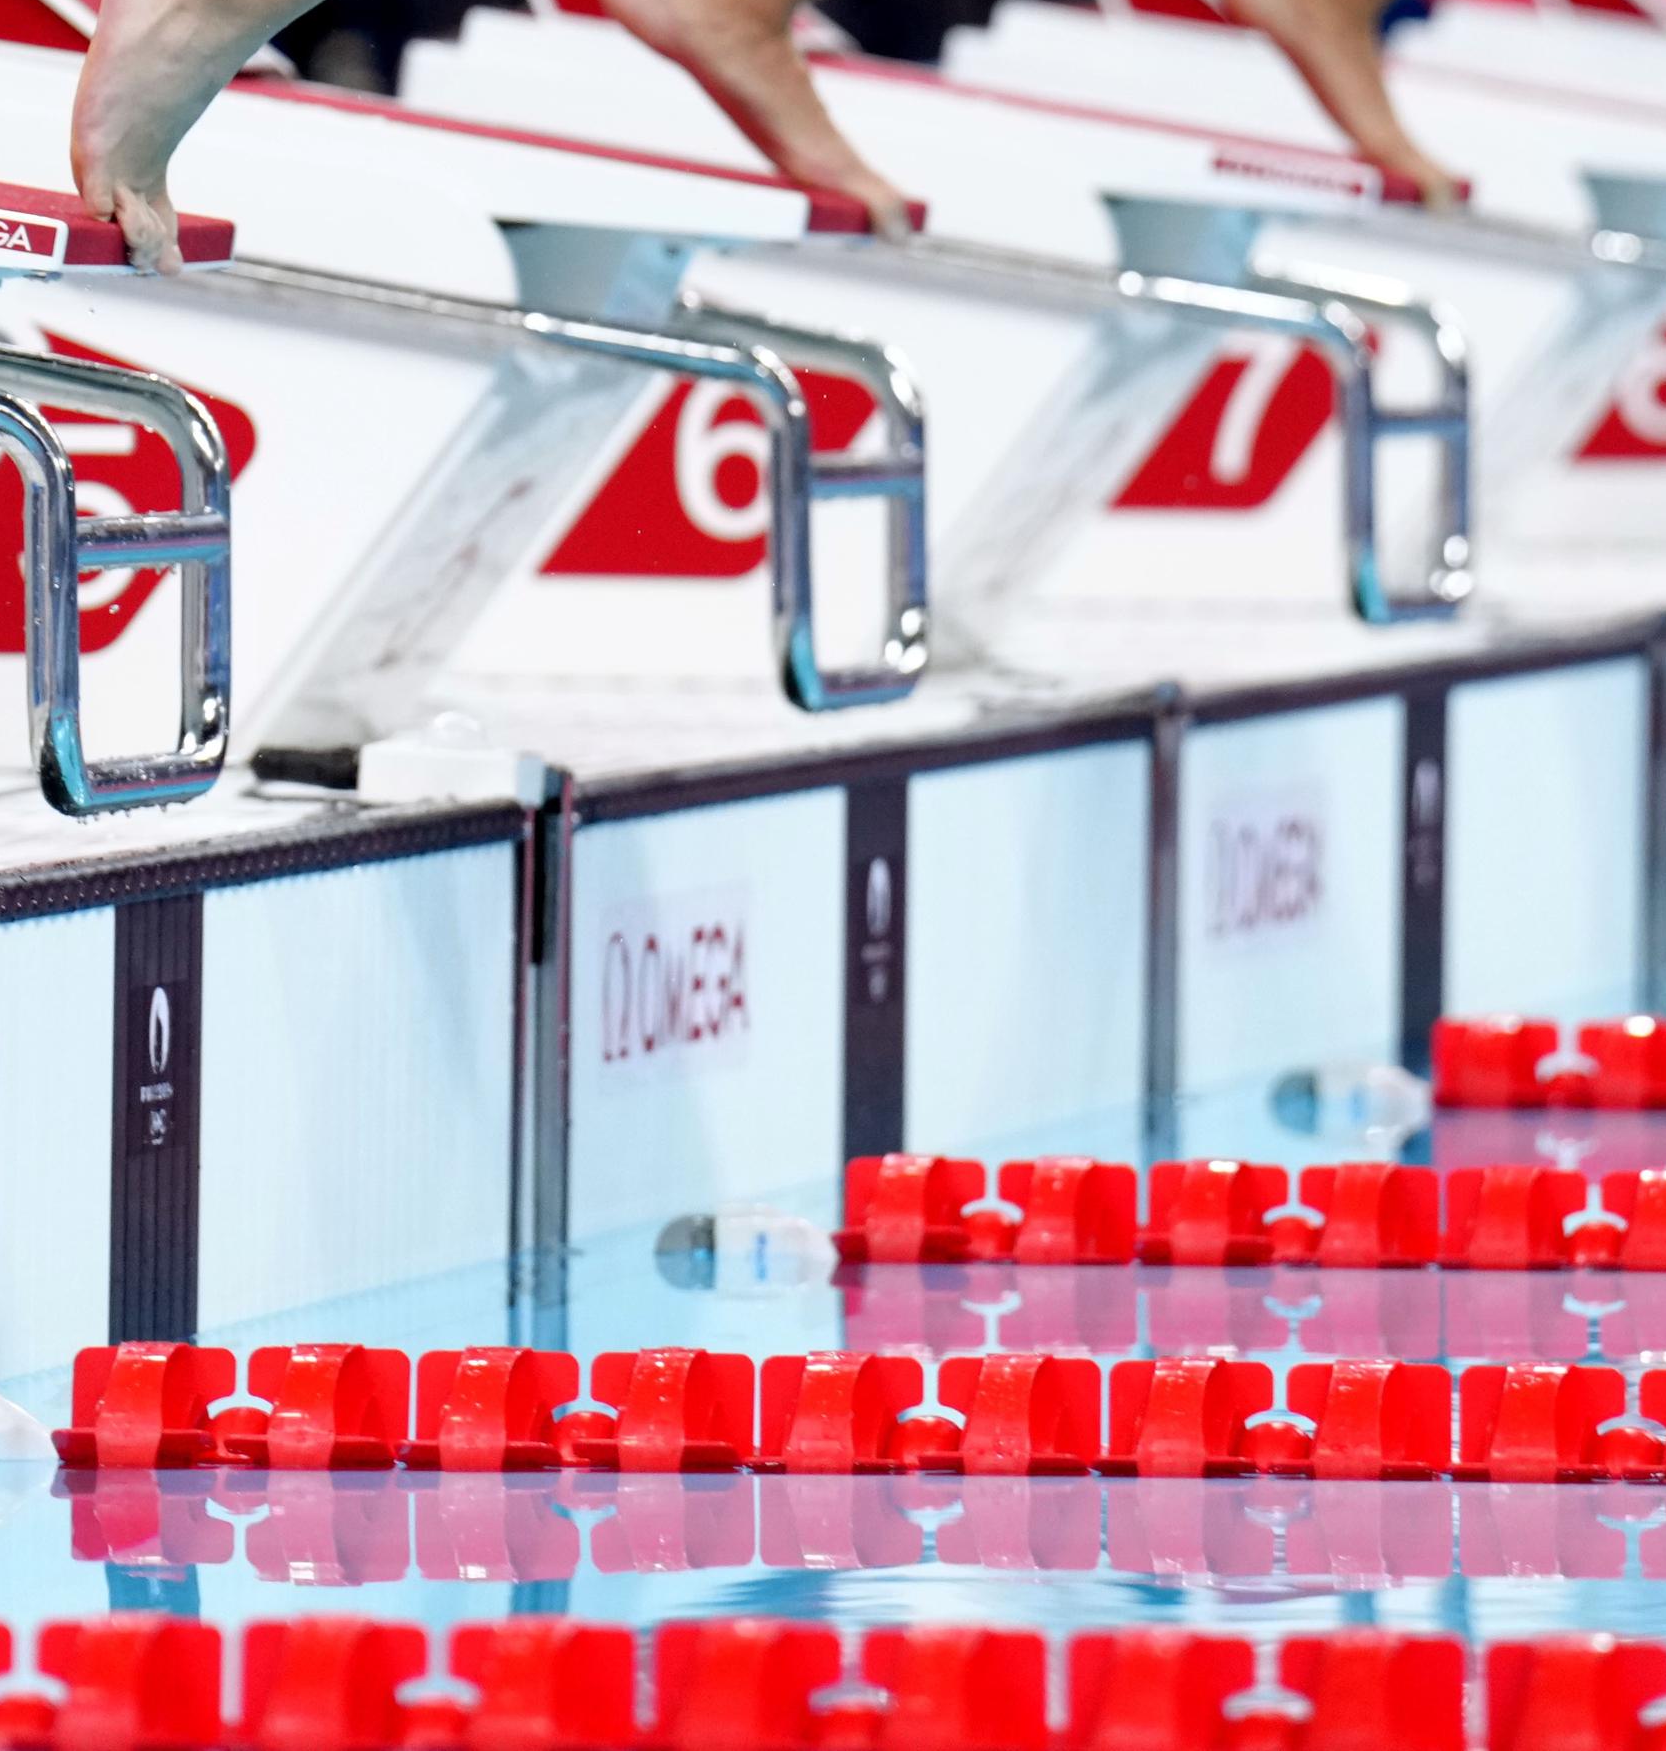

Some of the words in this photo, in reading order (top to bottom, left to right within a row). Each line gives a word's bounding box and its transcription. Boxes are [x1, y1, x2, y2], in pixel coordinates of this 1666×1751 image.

[673, 378, 779, 542] 6
[1209, 327, 1300, 485] 7
[637, 923, 751, 1054] OMEGA
